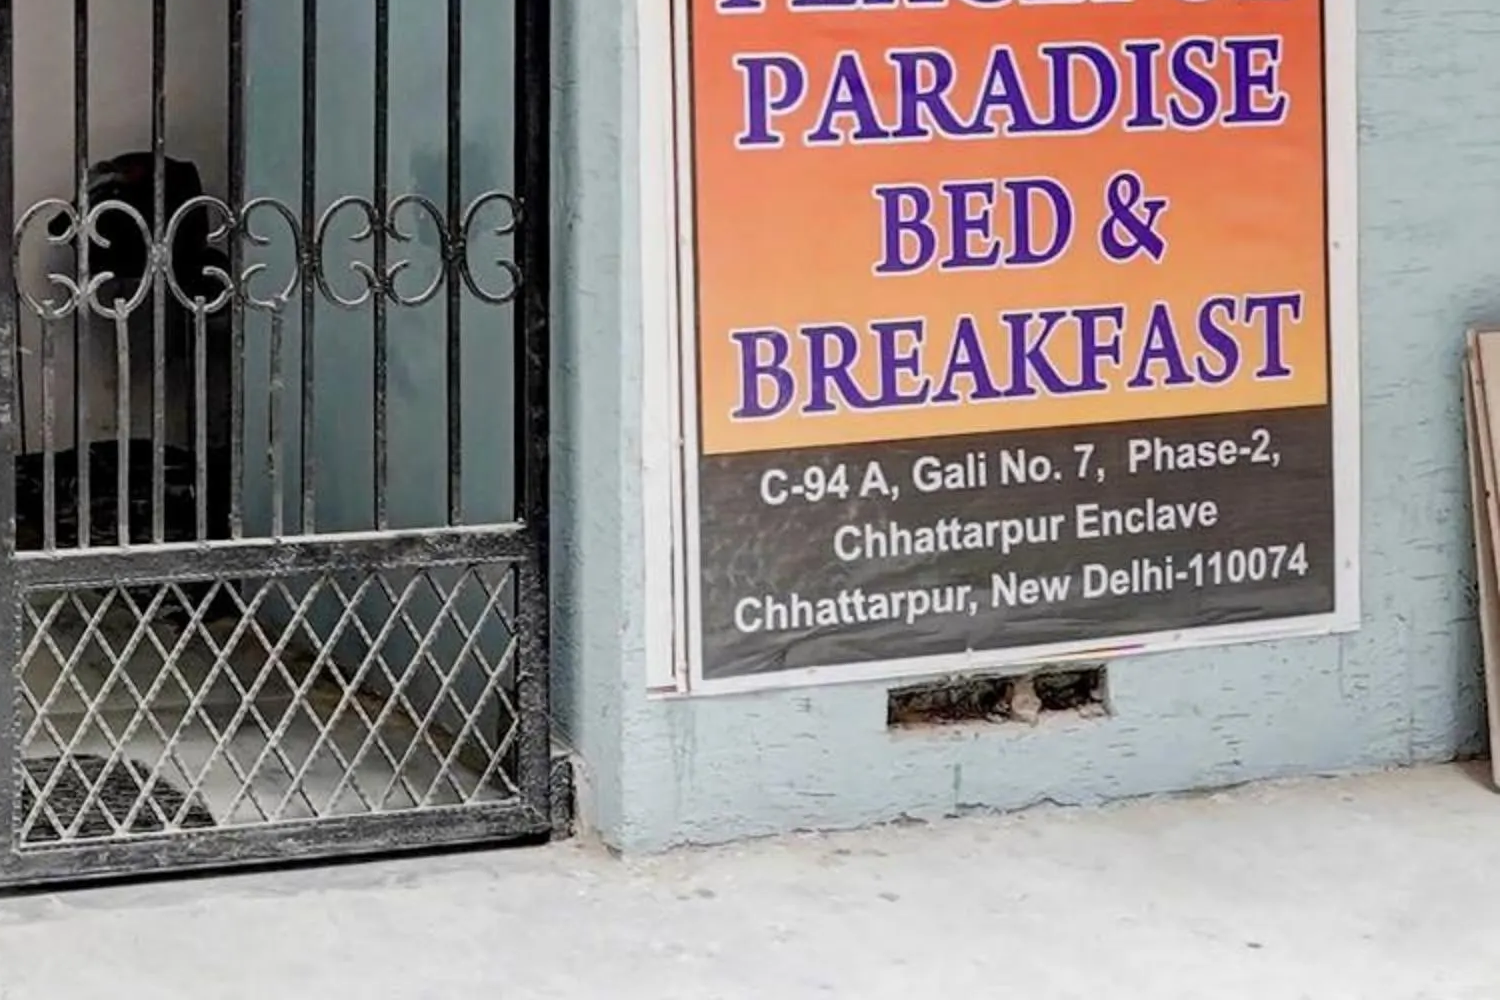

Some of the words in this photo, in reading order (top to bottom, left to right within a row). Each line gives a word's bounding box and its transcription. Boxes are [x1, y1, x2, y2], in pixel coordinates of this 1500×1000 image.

[734, 35, 1290, 149] PARADISE
[872, 176, 1077, 275] BED
[1100, 170, 1168, 264] &
[729, 291, 1304, 422] BREAKFAST
[760, 467, 849, 505] C-94
[860, 460, 900, 500] A,
[912, 453, 988, 492] Gali
[1001, 448, 1062, 486] No.
[1074, 444, 1105, 483] 7,
[1128, 428, 1282, 473] Phase-2,
[833, 510, 1065, 562] Chhattarpur
[1076, 497, 1219, 539] Enclave
[733, 581, 978, 634] Chhattarpur,
[991, 571, 1072, 610] New
[1083, 543, 1309, 598] Delhi-110074
